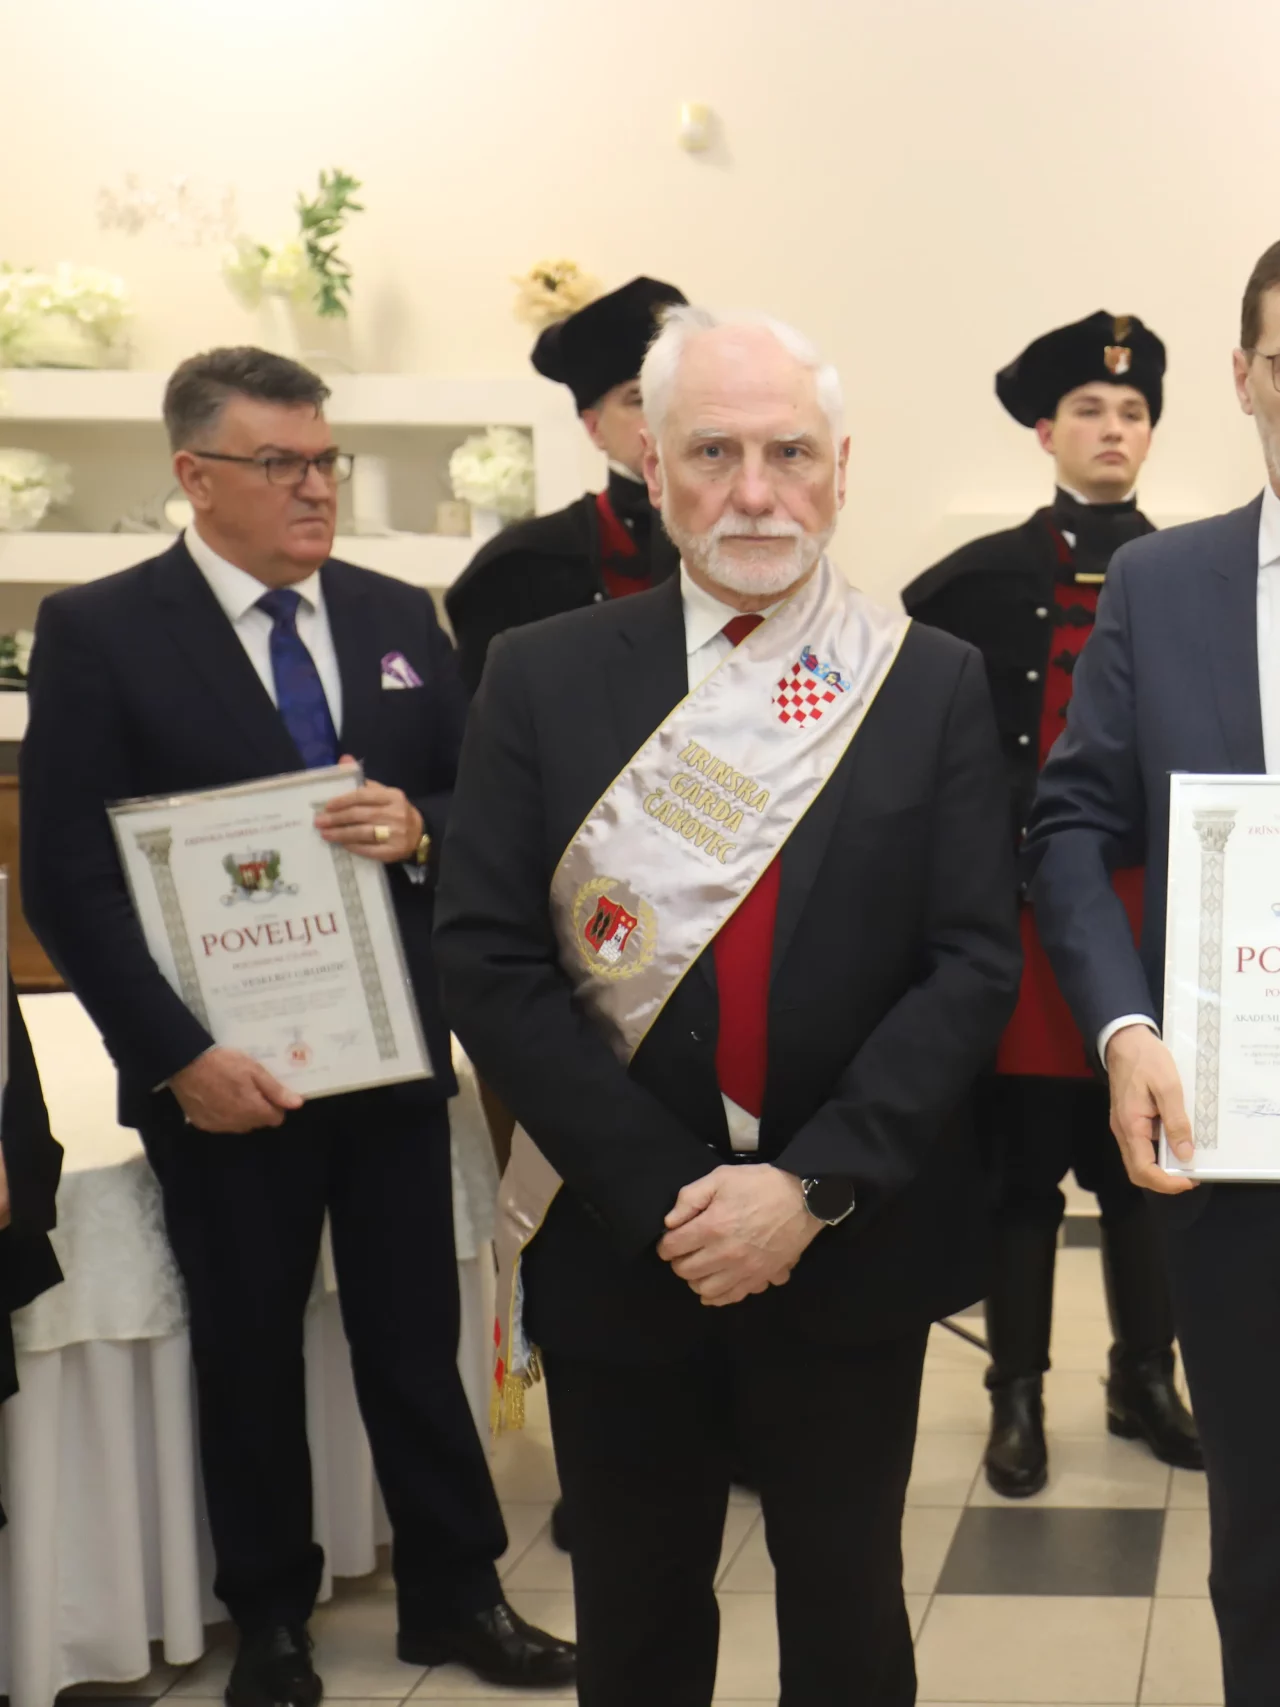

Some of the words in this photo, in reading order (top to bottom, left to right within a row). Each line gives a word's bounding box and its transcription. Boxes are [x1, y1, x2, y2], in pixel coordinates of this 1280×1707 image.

[669, 772, 744, 833] GARDA
[677, 739, 770, 813] ZRINSKA
[642, 787, 737, 864] ČAKOVEC
[201, 911, 339, 957] POVELJU
